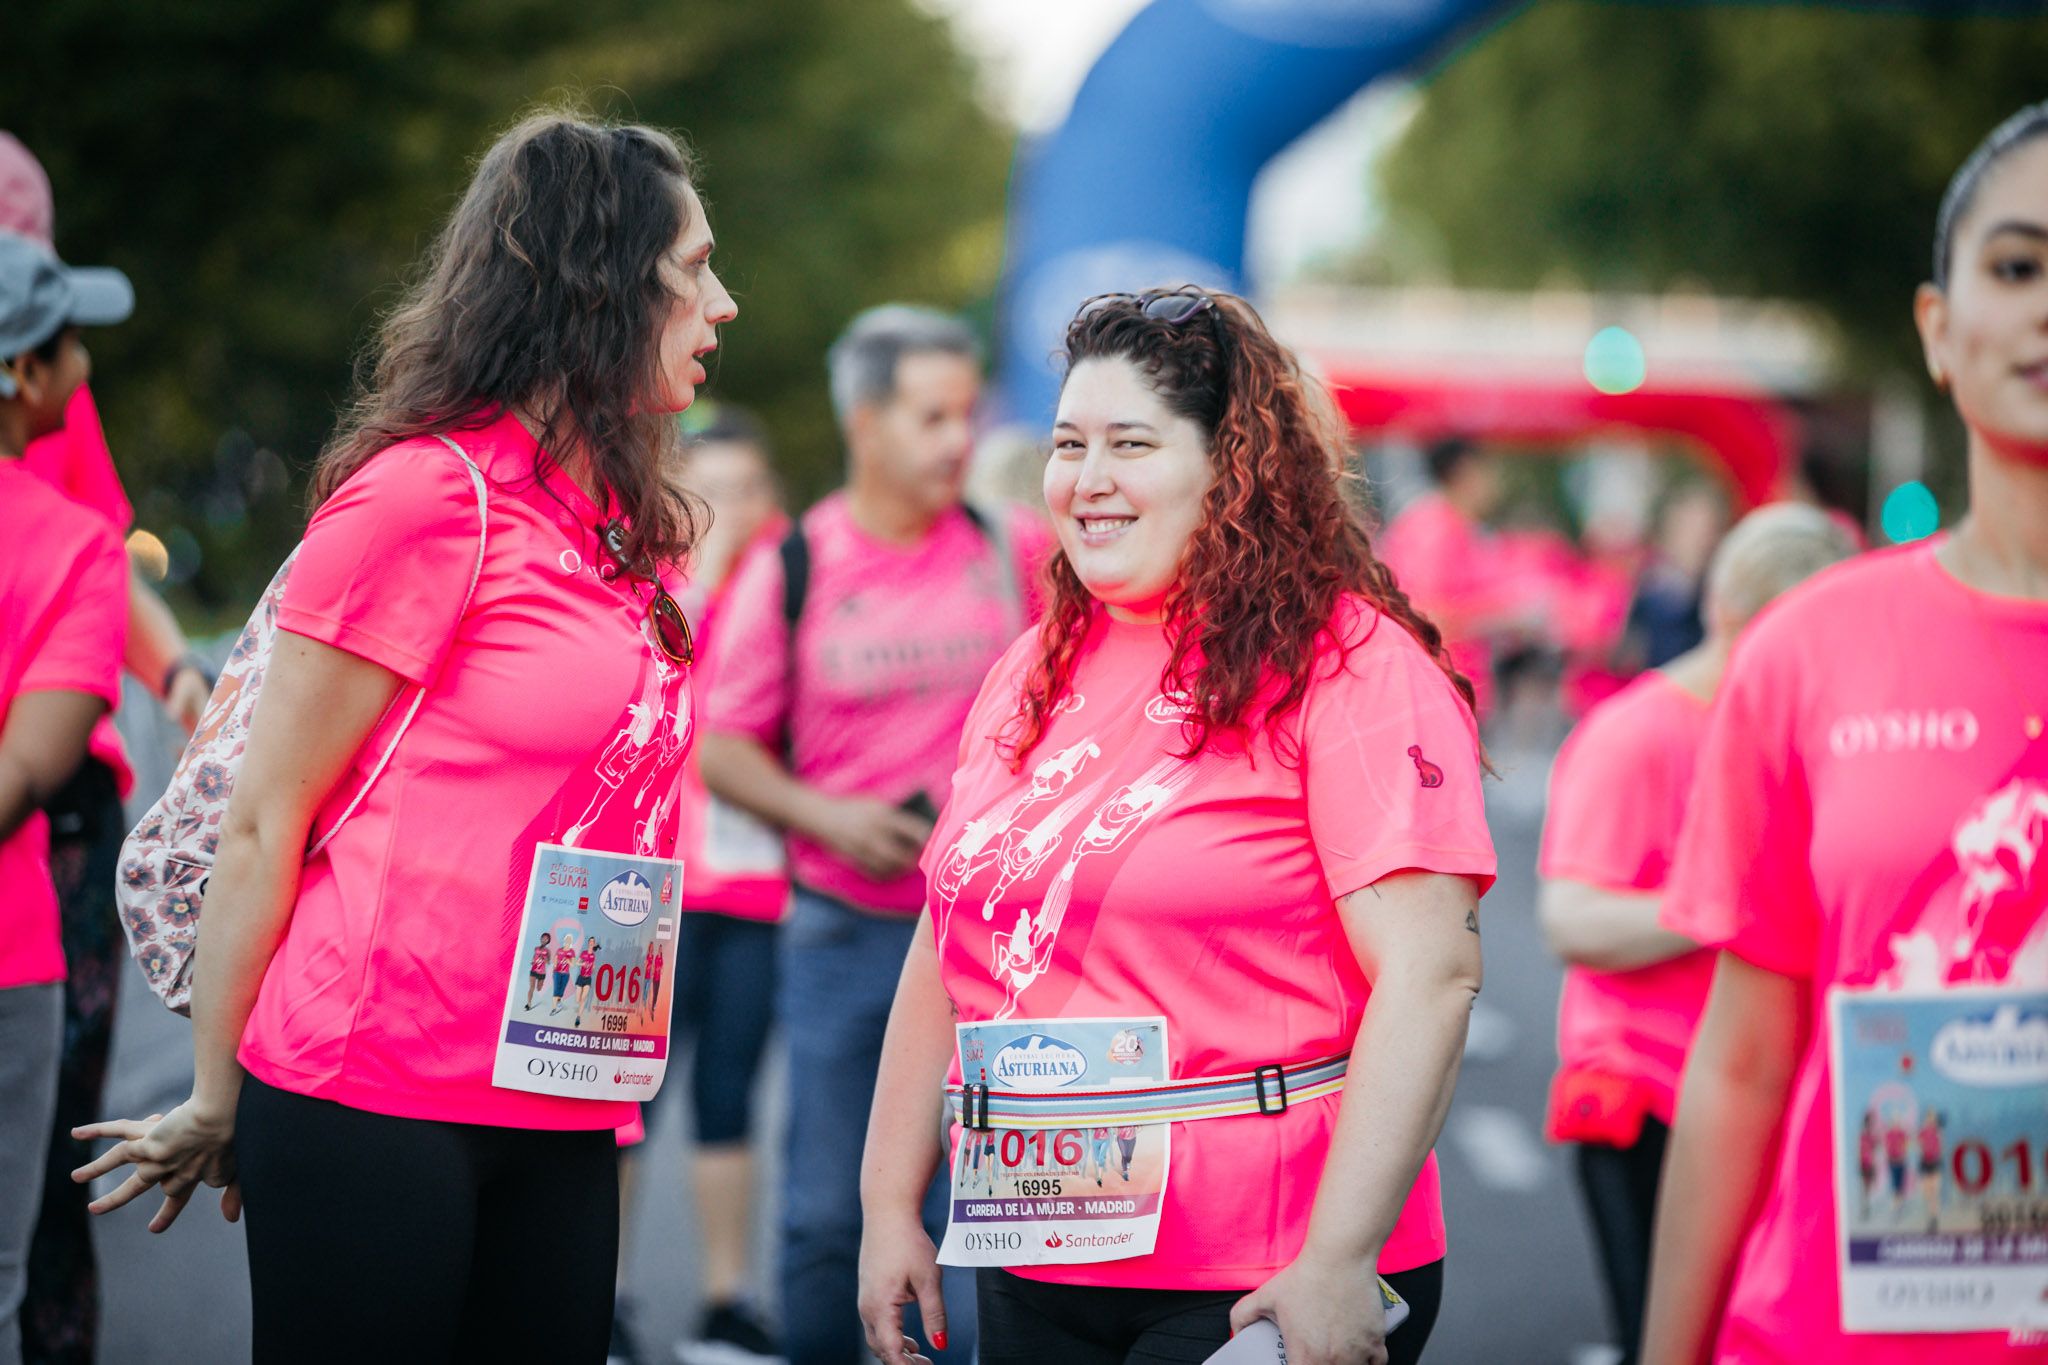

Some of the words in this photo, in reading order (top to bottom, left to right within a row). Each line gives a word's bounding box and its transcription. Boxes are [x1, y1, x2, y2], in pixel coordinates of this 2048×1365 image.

[548, 872, 588, 889] SUMA
[595, 963, 641, 1004] 016
[601, 1014, 628, 1032] 16996
[534, 1029, 588, 1049] CARRERA
[590, 1038, 600, 1050] DE
[601, 1038, 611, 1050] LA
[632, 1040, 655, 1053] MADRID
[1113, 1033, 1138, 1053] 20
[527, 1058, 598, 1083] OYSHO
[998, 1056, 1079, 1077] ASTURIANA
[621, 1071, 654, 1086] Santander
[1000, 1129, 1083, 1168] 016
[1951, 1136, 2048, 1197] 01
[1013, 1179, 1062, 1196] 16995
[966, 1202, 1003, 1217] CARRERA
[1005, 1203, 1019, 1216] DE
[1020, 1203, 1034, 1216] LA
[1037, 1202, 1075, 1216] MUJER
[1085, 1200, 1136, 1214] MADRID
[965, 1232, 1022, 1251] OYSHO
[1066, 1231, 1134, 1248] Santander
